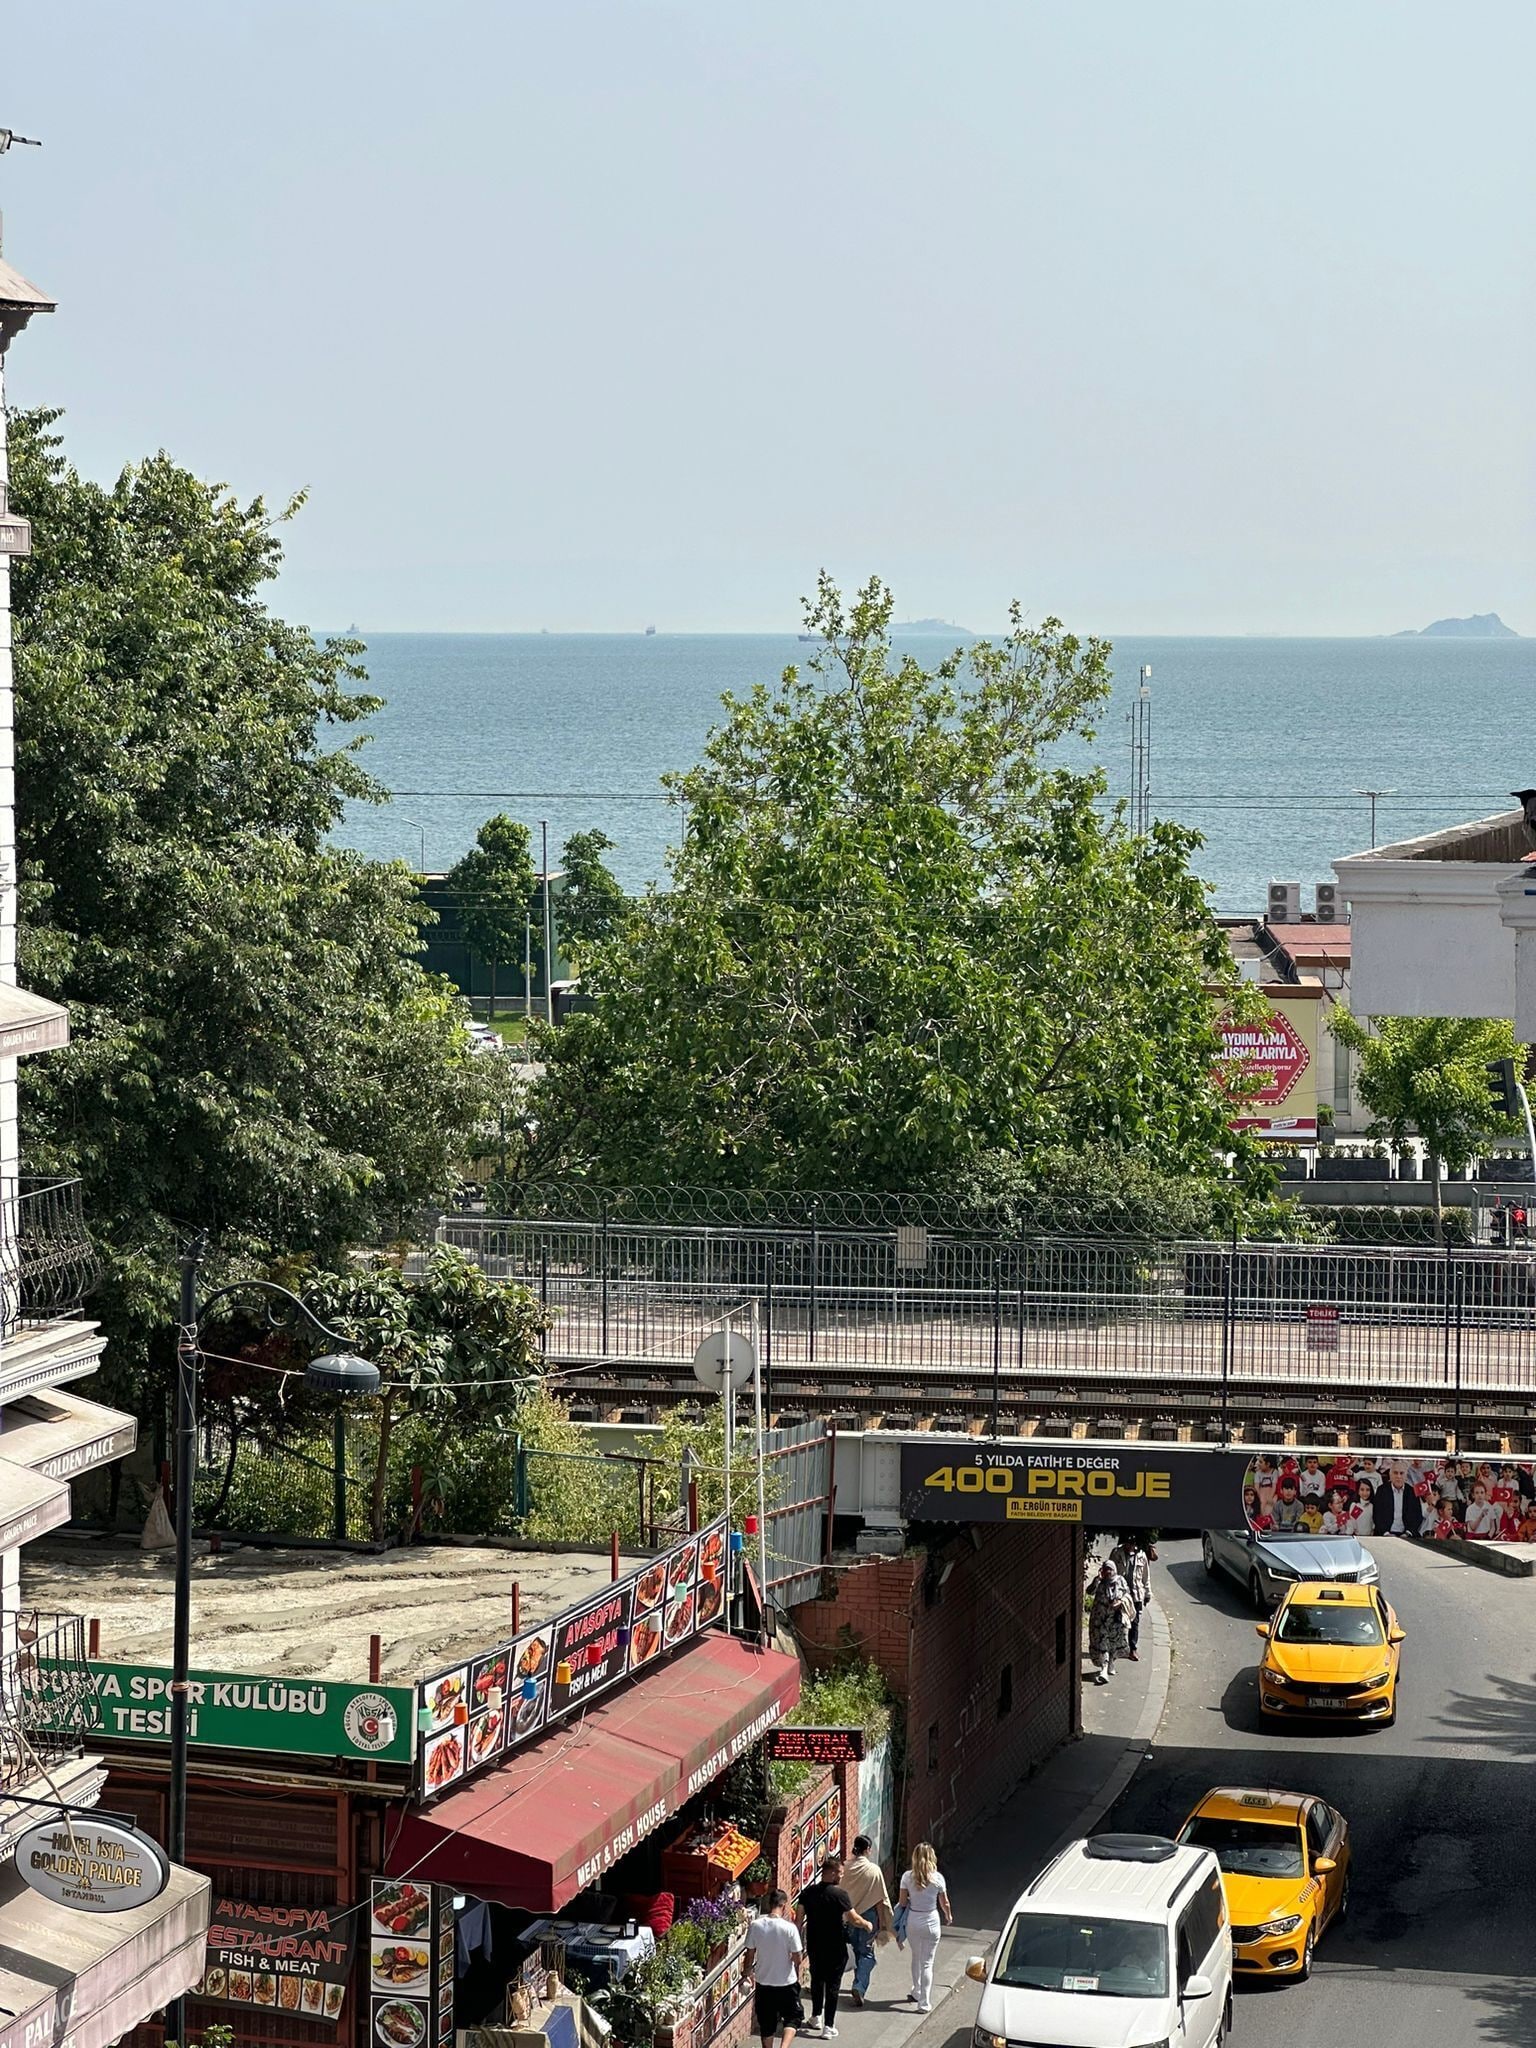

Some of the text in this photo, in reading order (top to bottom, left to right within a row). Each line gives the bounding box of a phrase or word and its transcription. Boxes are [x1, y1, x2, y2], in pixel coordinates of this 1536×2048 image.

[42, 1436, 114, 1477] GOLDEN PALCE
[975, 1454, 1120, 1470] 5 YILDA FATİH'E DEĞER
[924, 1467, 1171, 1498] 400 PROJE
[1011, 1501, 1022, 1511] M.
[1051, 1502, 1078, 1512] TURAN
[3, 1523, 23, 1541] GOLDEN
[564, 1597, 622, 1648] AYASOFYA
[583, 1671, 591, 1688] &
[590, 1659, 609, 1684] MEAT
[213, 1682, 327, 1715] KULÜBÜ
[112, 1704, 198, 1737] TESİİ
[688, 1700, 781, 1795] AYASOFYA RESTAURANT
[51, 1832, 125, 1862] HOTEL İSTA
[577, 1799, 667, 1888] MEAT & FISH HOUSE
[31, 1851, 143, 1888] GOLDEN PALACE
[216, 1899, 331, 1933] AYASOFYA
[219, 1950, 321, 1976] FISH & MEAT
